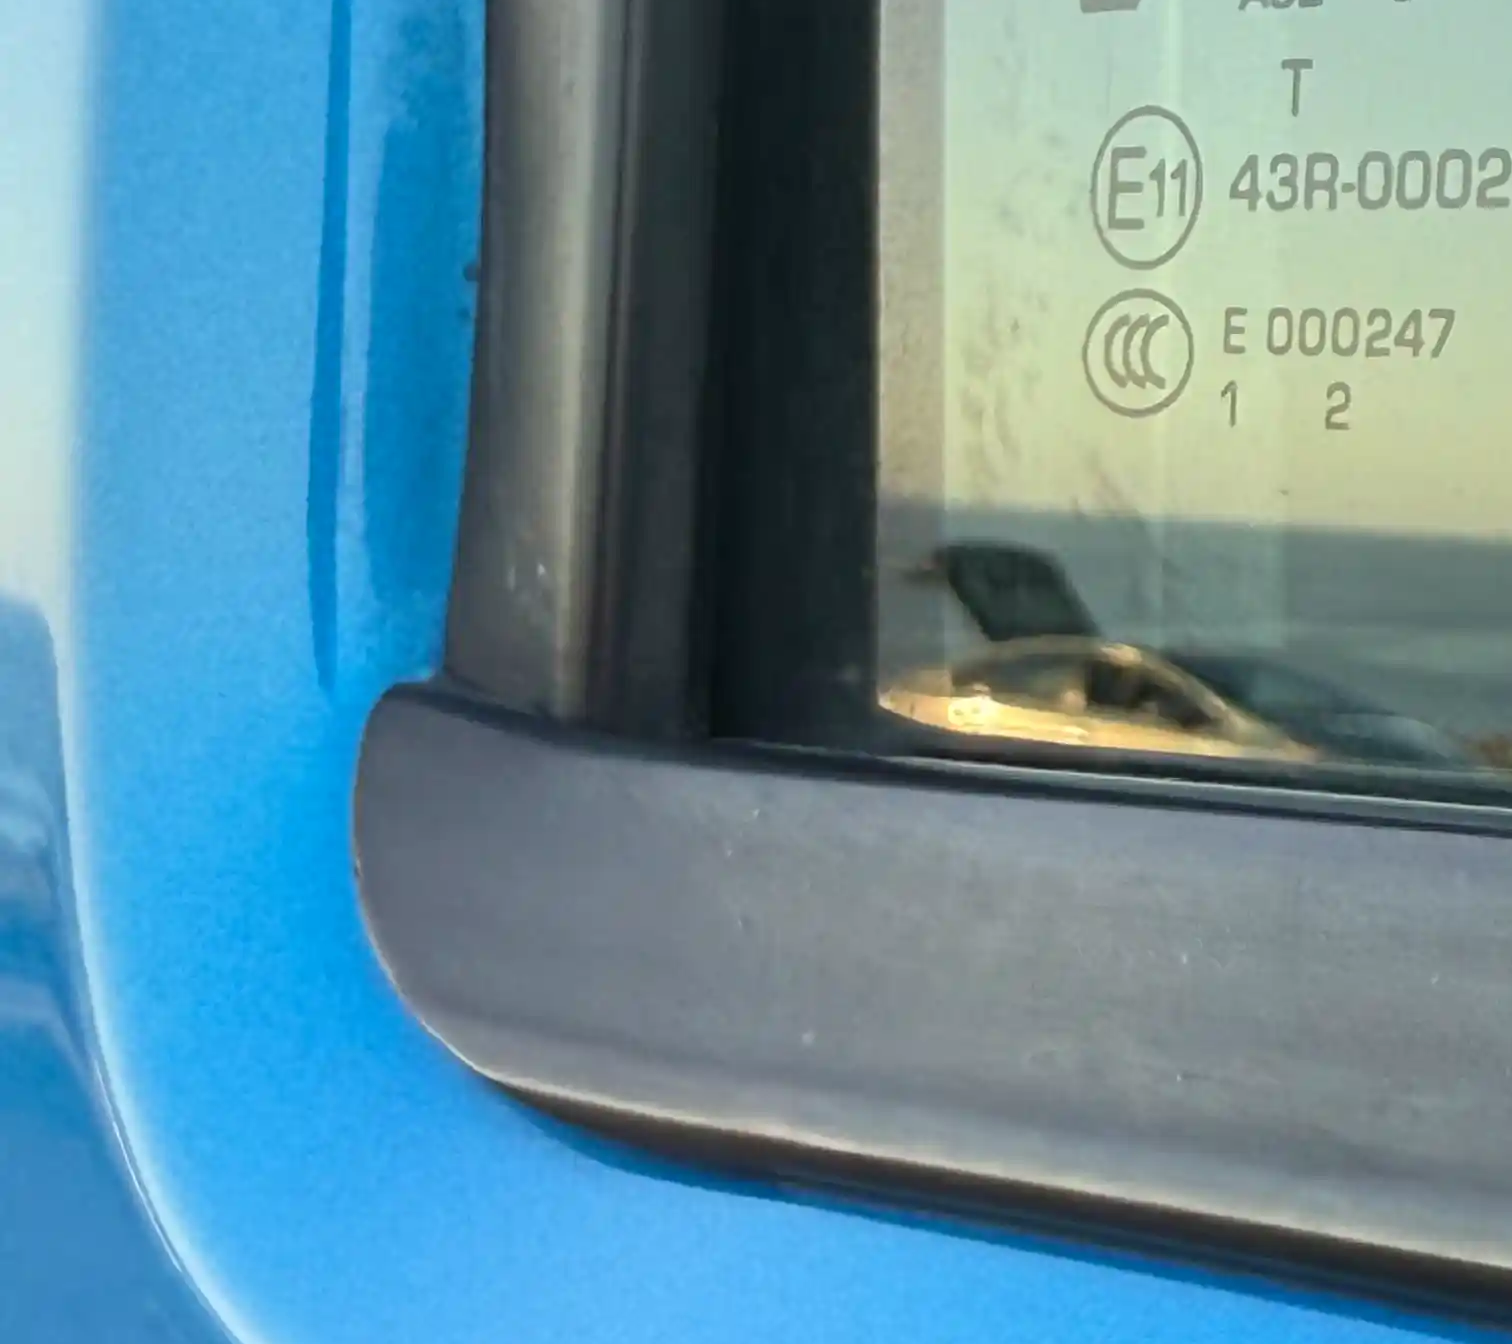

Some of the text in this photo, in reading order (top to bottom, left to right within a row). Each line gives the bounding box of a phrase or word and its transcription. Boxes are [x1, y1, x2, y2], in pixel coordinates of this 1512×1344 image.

[1280, 57, 1314, 118] T
[1222, 306, 1457, 360] E 000247
[1220, 379, 1239, 429] 1
[1323, 381, 1352, 431] 2
